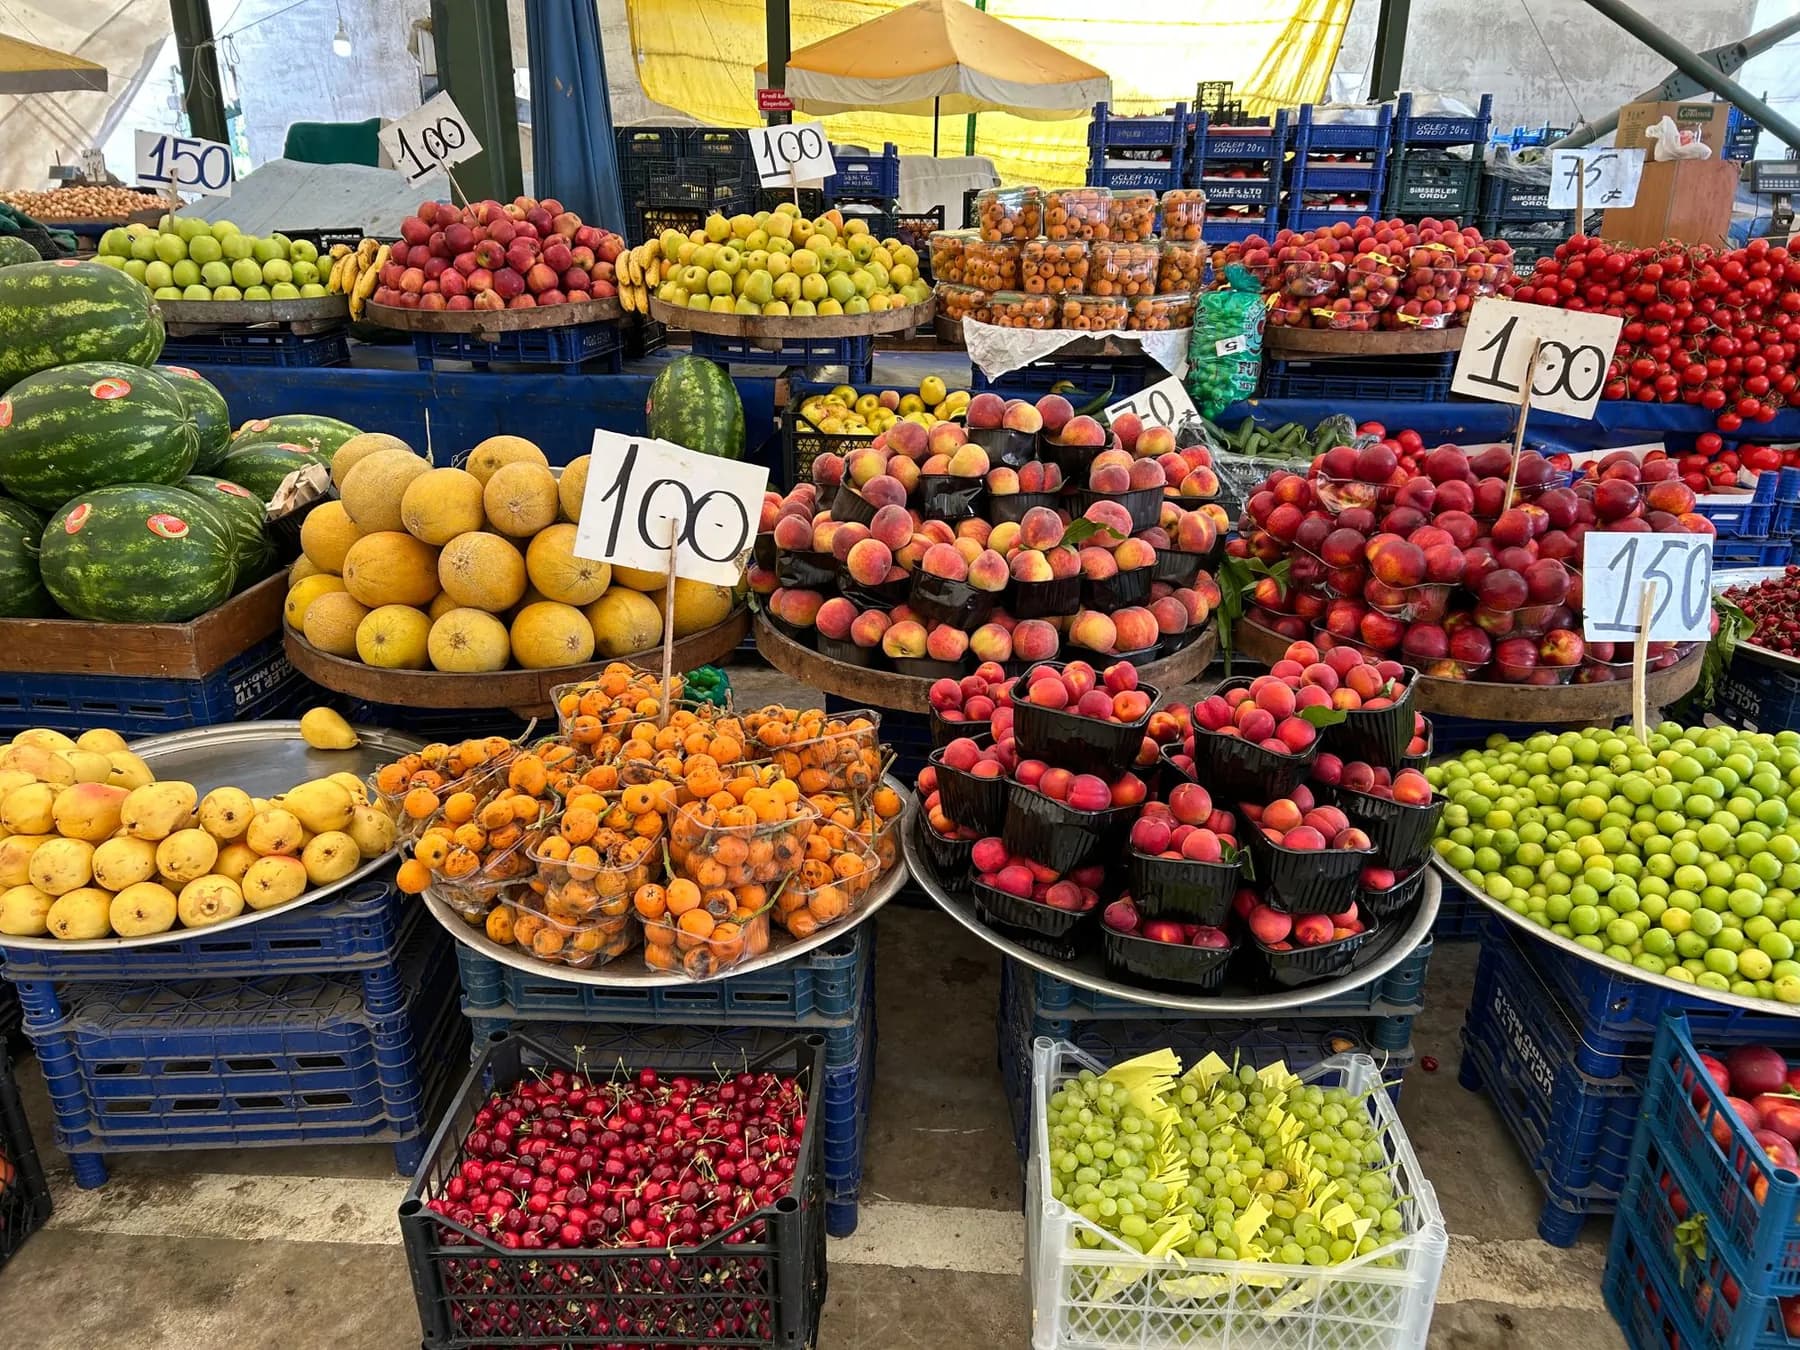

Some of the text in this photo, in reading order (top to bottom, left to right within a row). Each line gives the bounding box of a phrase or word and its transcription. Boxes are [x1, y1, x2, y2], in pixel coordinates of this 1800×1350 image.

[138, 134, 231, 190] 150
[398, 117, 465, 179] 100
[761, 128, 822, 179] 100
[1561, 153, 1618, 191] 75
[1243, 187, 1262, 195] LTD
[1467, 316, 1606, 401] 100
[601, 444, 749, 562] 100
[1593, 538, 1713, 635] 150
[235, 681, 262, 706] LTD
[1524, 1034, 1555, 1081] ORDU
